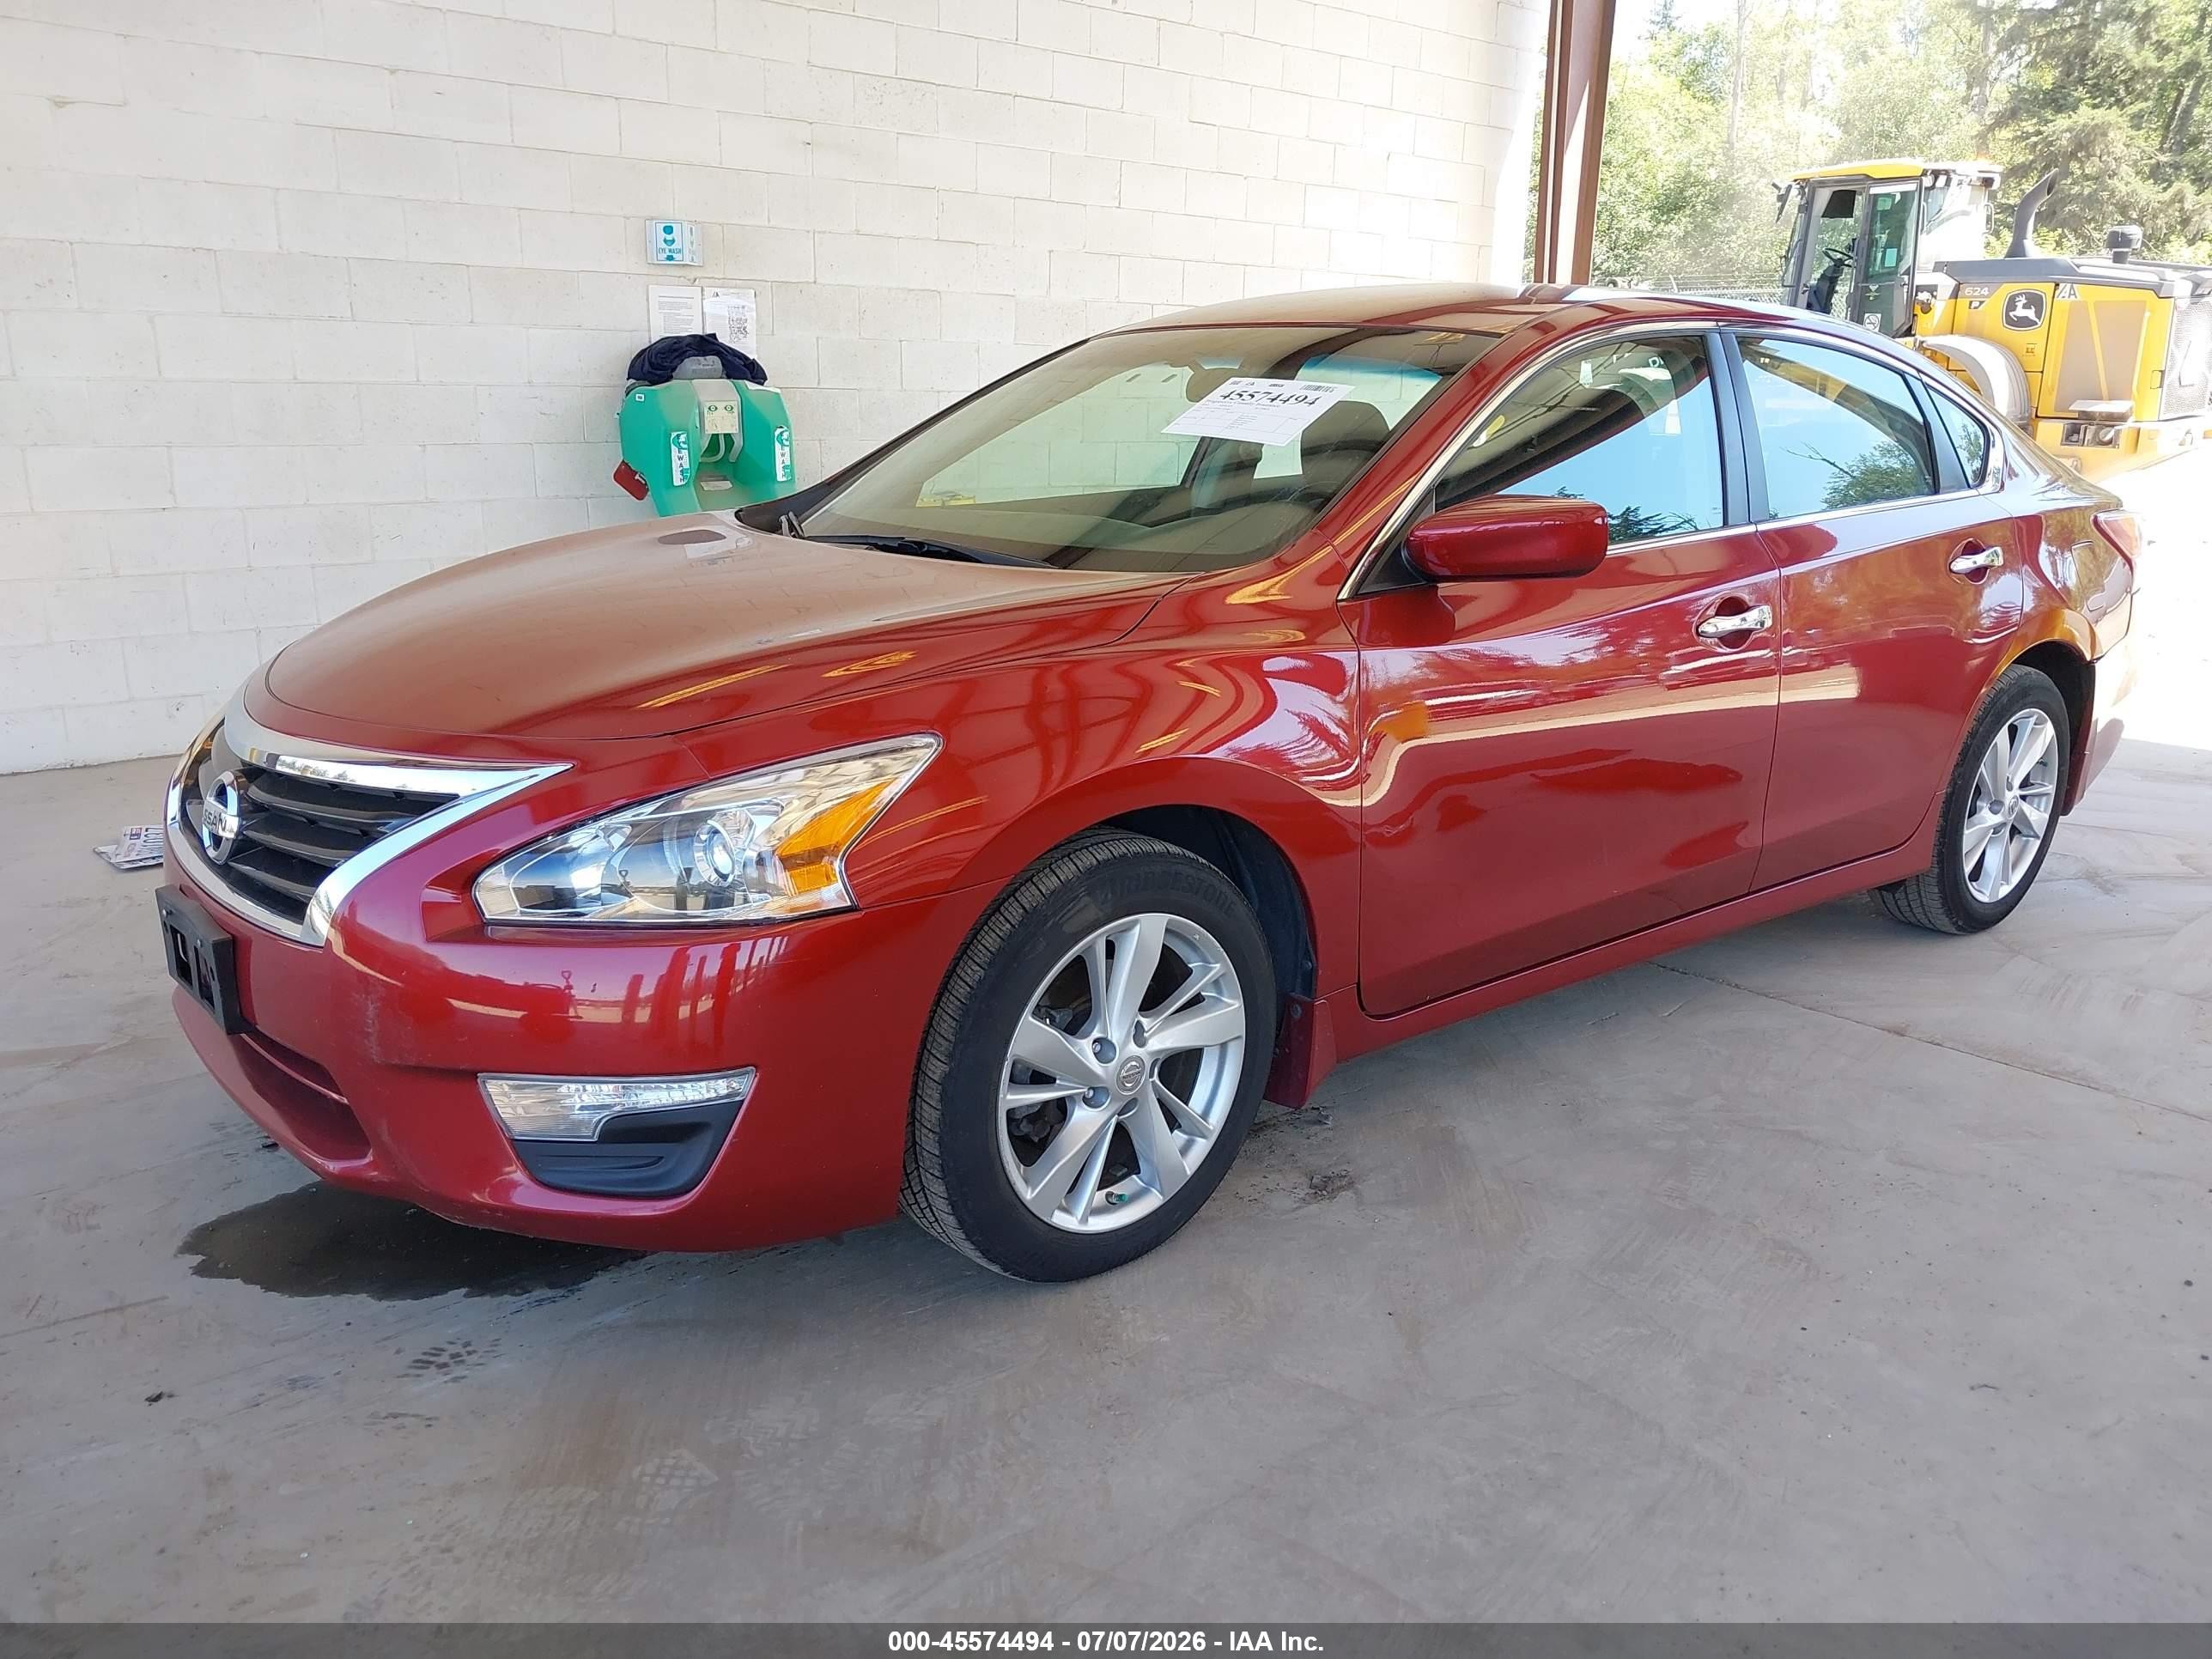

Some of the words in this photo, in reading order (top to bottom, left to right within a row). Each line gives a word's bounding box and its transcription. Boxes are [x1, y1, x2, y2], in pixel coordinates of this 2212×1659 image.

[1965, 287, 1989, 296] 624
[1971, 301, 1980, 309] P
[1219, 389, 1322, 406] 45574494
